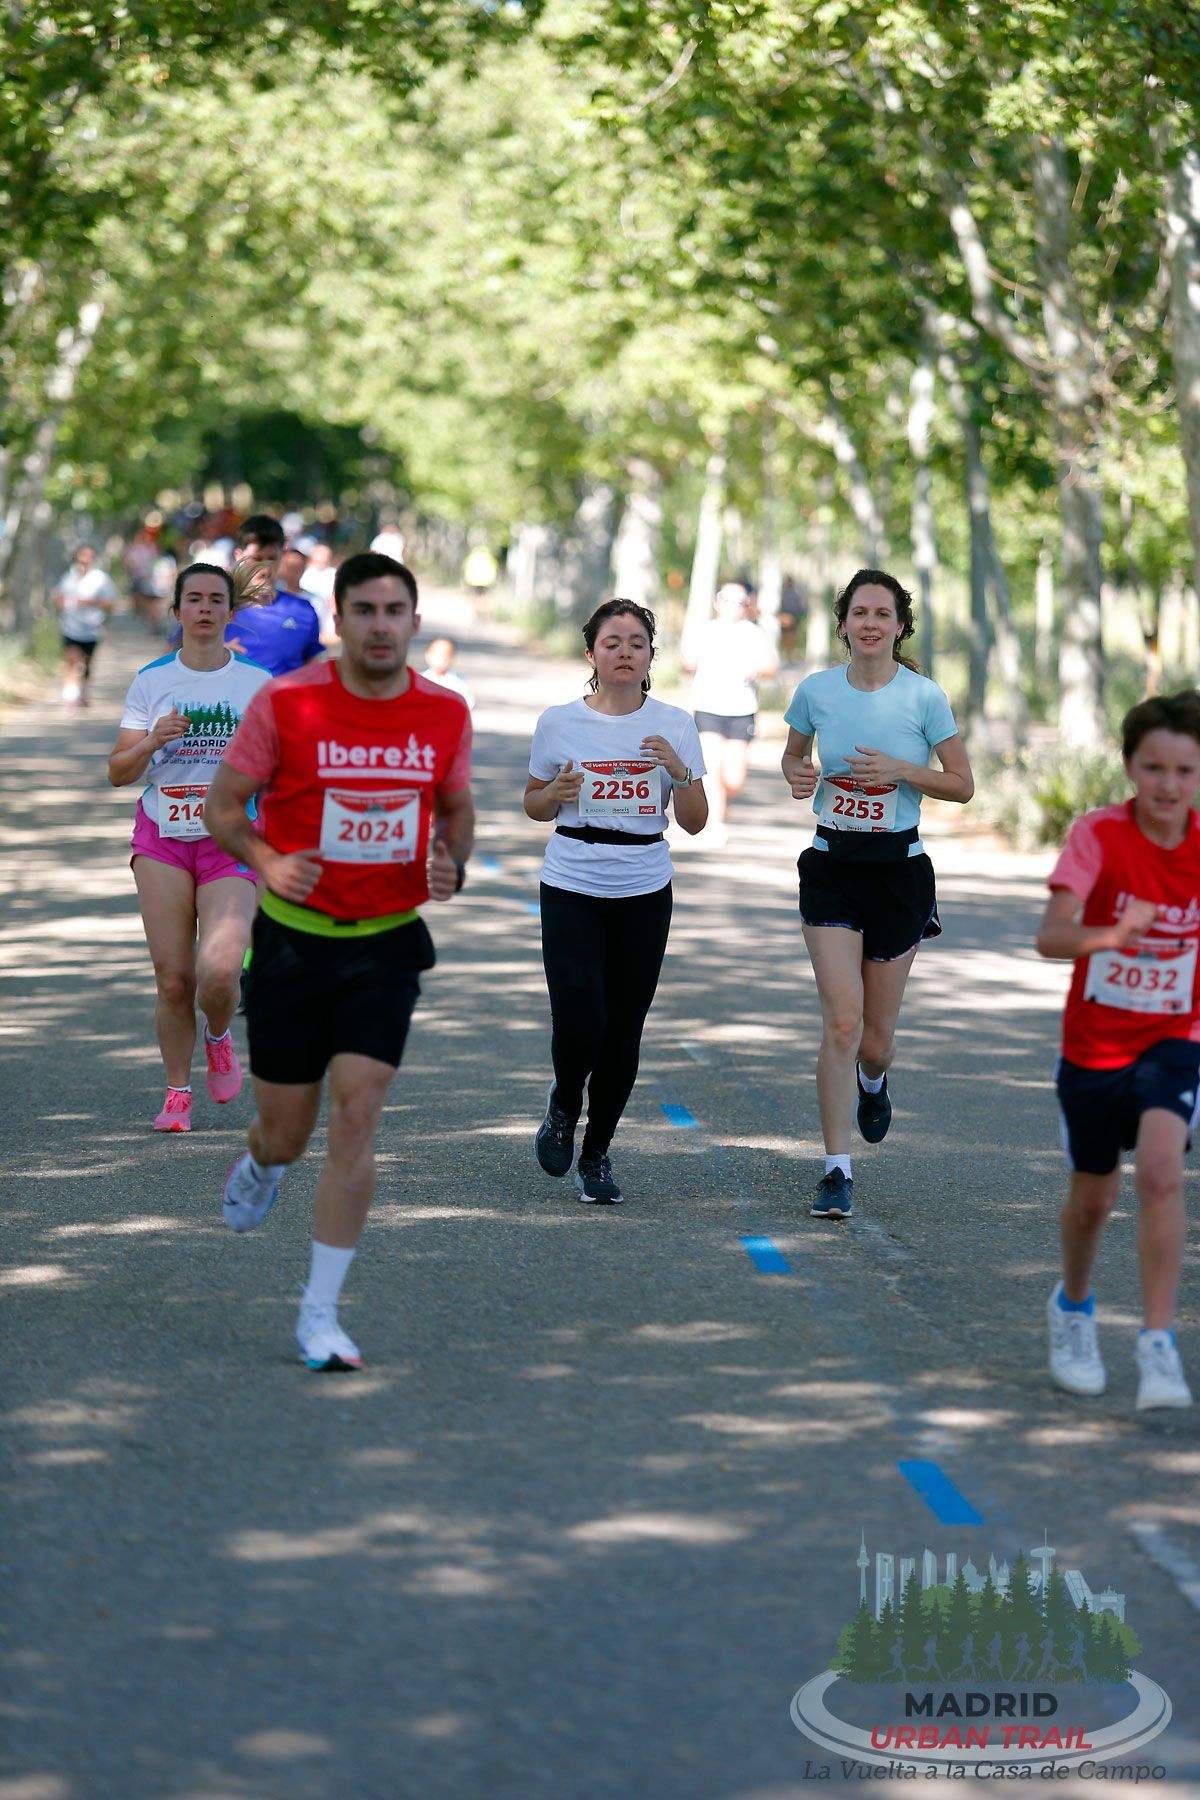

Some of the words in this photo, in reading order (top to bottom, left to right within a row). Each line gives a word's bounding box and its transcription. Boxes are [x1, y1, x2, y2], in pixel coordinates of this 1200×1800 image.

[182, 739, 227, 748] MADRID
[317, 733, 436, 770] Iberext
[591, 780, 650, 800] 2256
[169, 803, 204, 822] 214
[832, 795, 885, 821] 2253
[338, 819, 405, 842] 2024
[1105, 962, 1178, 992] 2032
